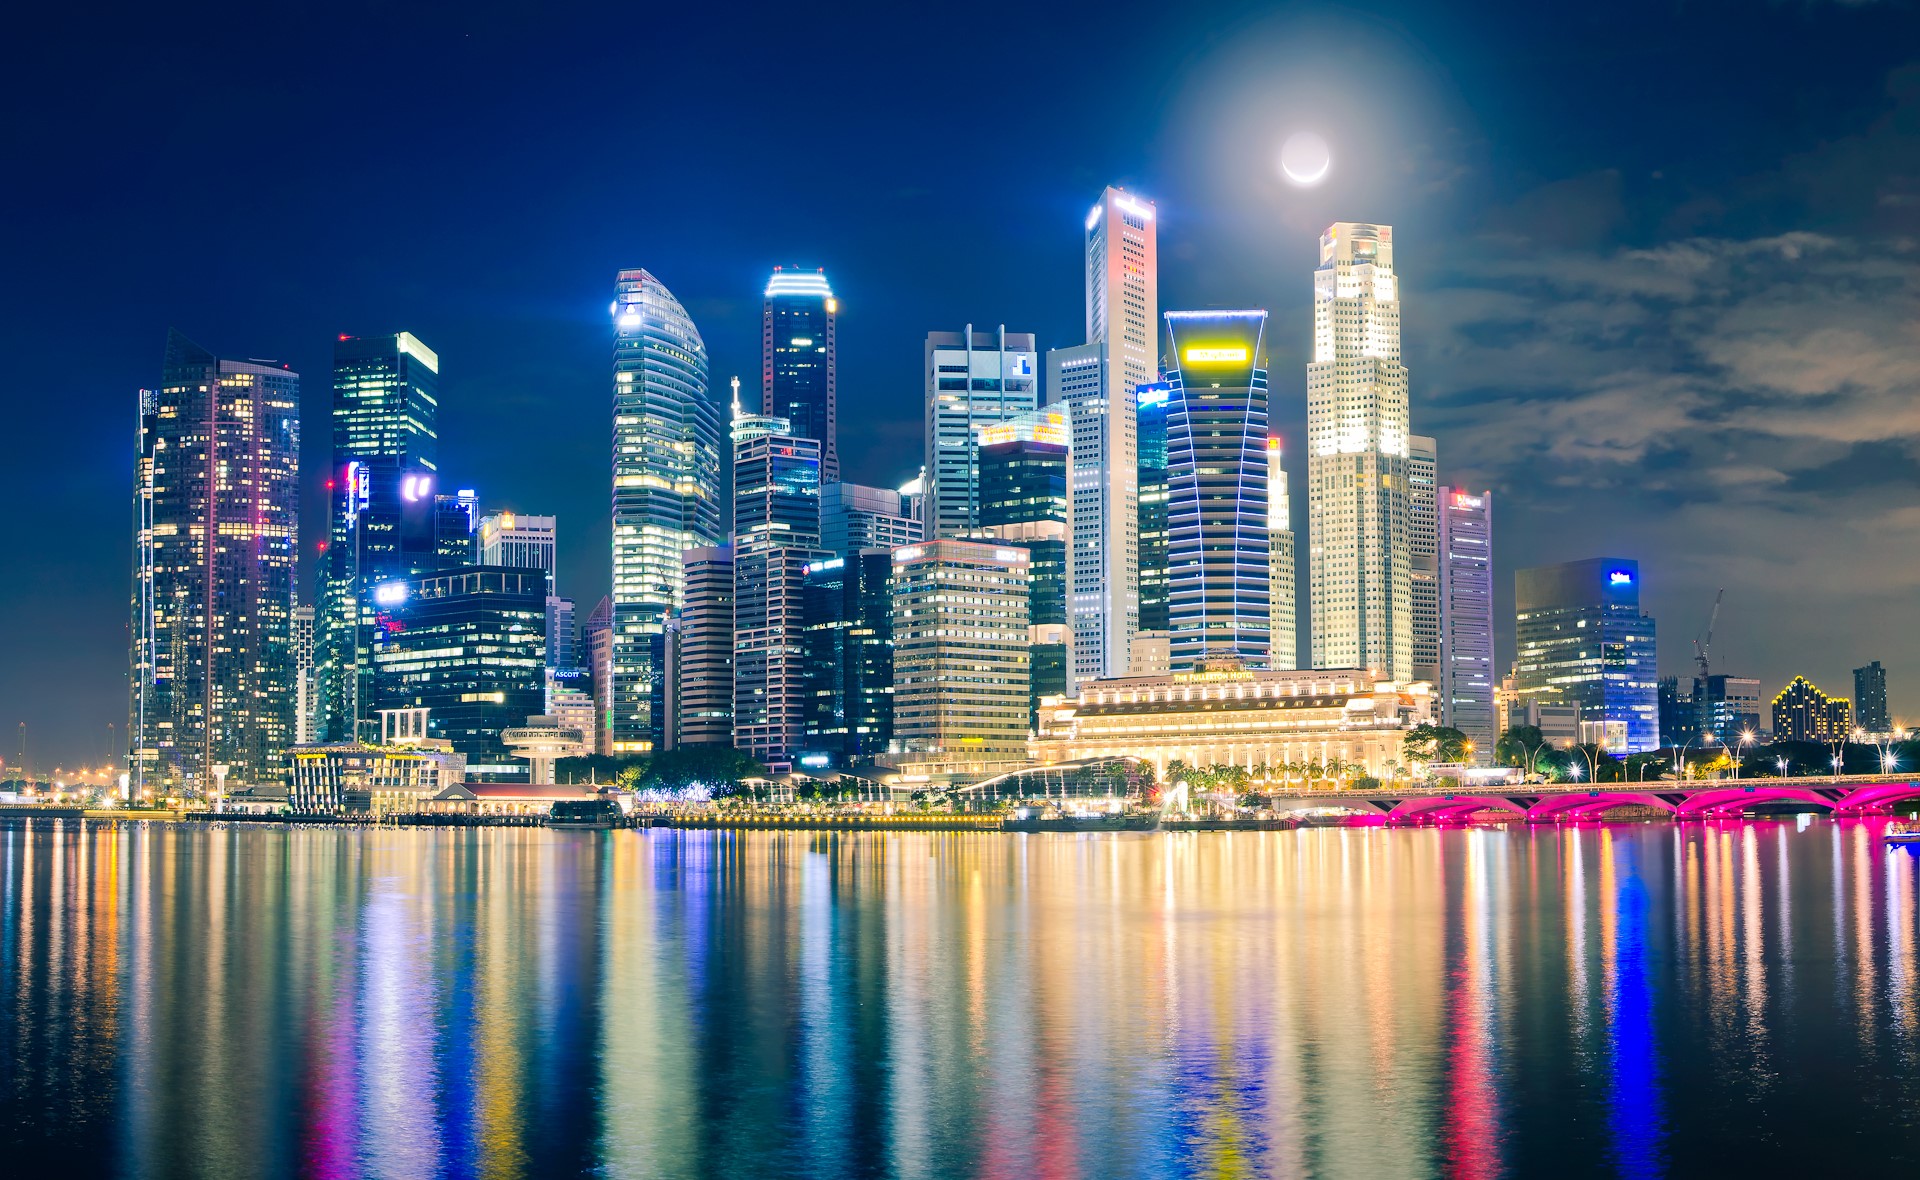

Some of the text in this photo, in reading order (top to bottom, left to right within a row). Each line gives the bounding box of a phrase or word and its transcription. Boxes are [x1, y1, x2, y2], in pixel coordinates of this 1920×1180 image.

[1174, 671, 1254, 682] THE FULLERTON HOTEL
